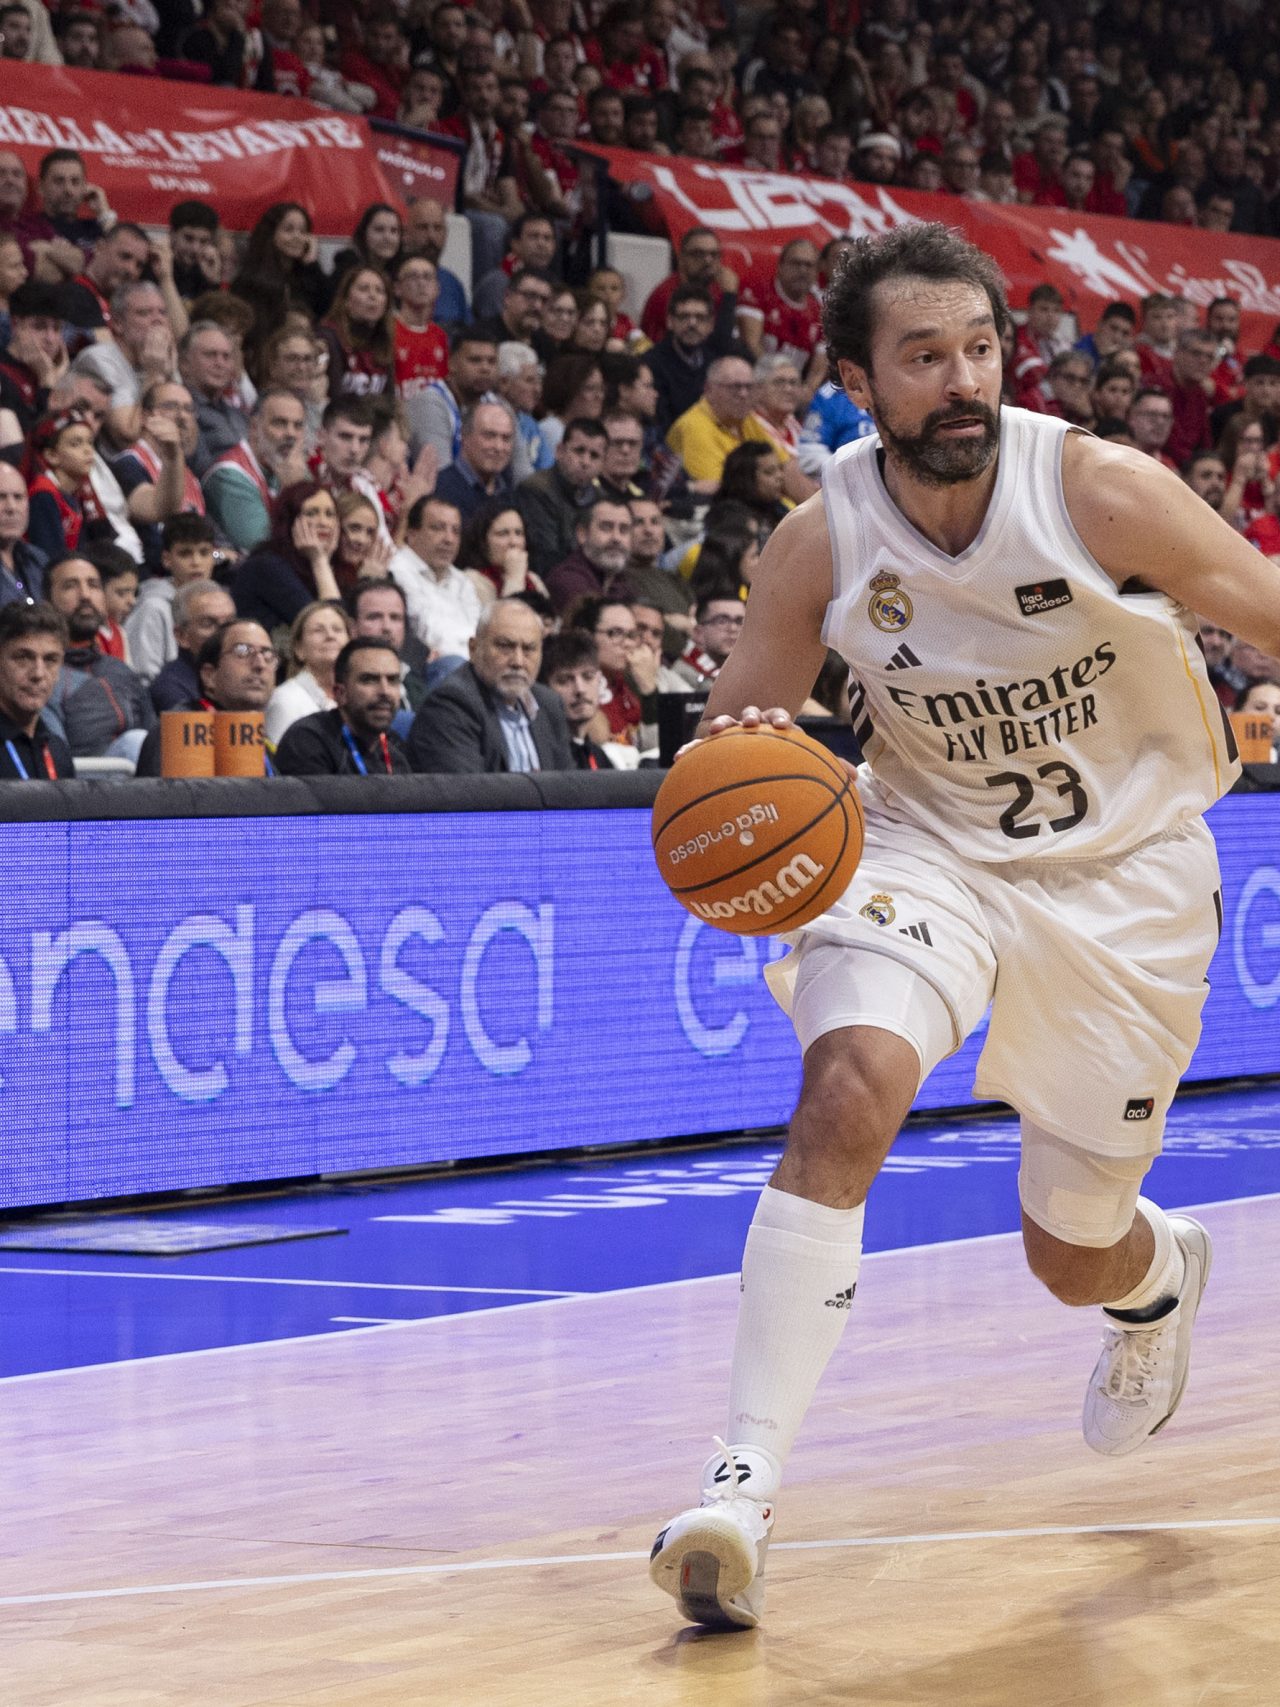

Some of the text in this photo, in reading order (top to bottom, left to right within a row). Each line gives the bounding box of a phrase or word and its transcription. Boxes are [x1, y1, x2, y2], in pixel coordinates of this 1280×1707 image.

[147, 117, 363, 162] LEVANTE
[1021, 594, 1043, 605] liga
[1024, 594, 1070, 613] endesa
[886, 642, 1117, 728] Emirates
[943, 693, 1099, 762] FLY BETTER
[985, 760, 1089, 840] 23
[669, 802, 780, 865] liga endesa
[690, 853, 825, 920] Wilson
[0, 900, 554, 1108] ndesa
[1127, 1107, 1148, 1119] acb
